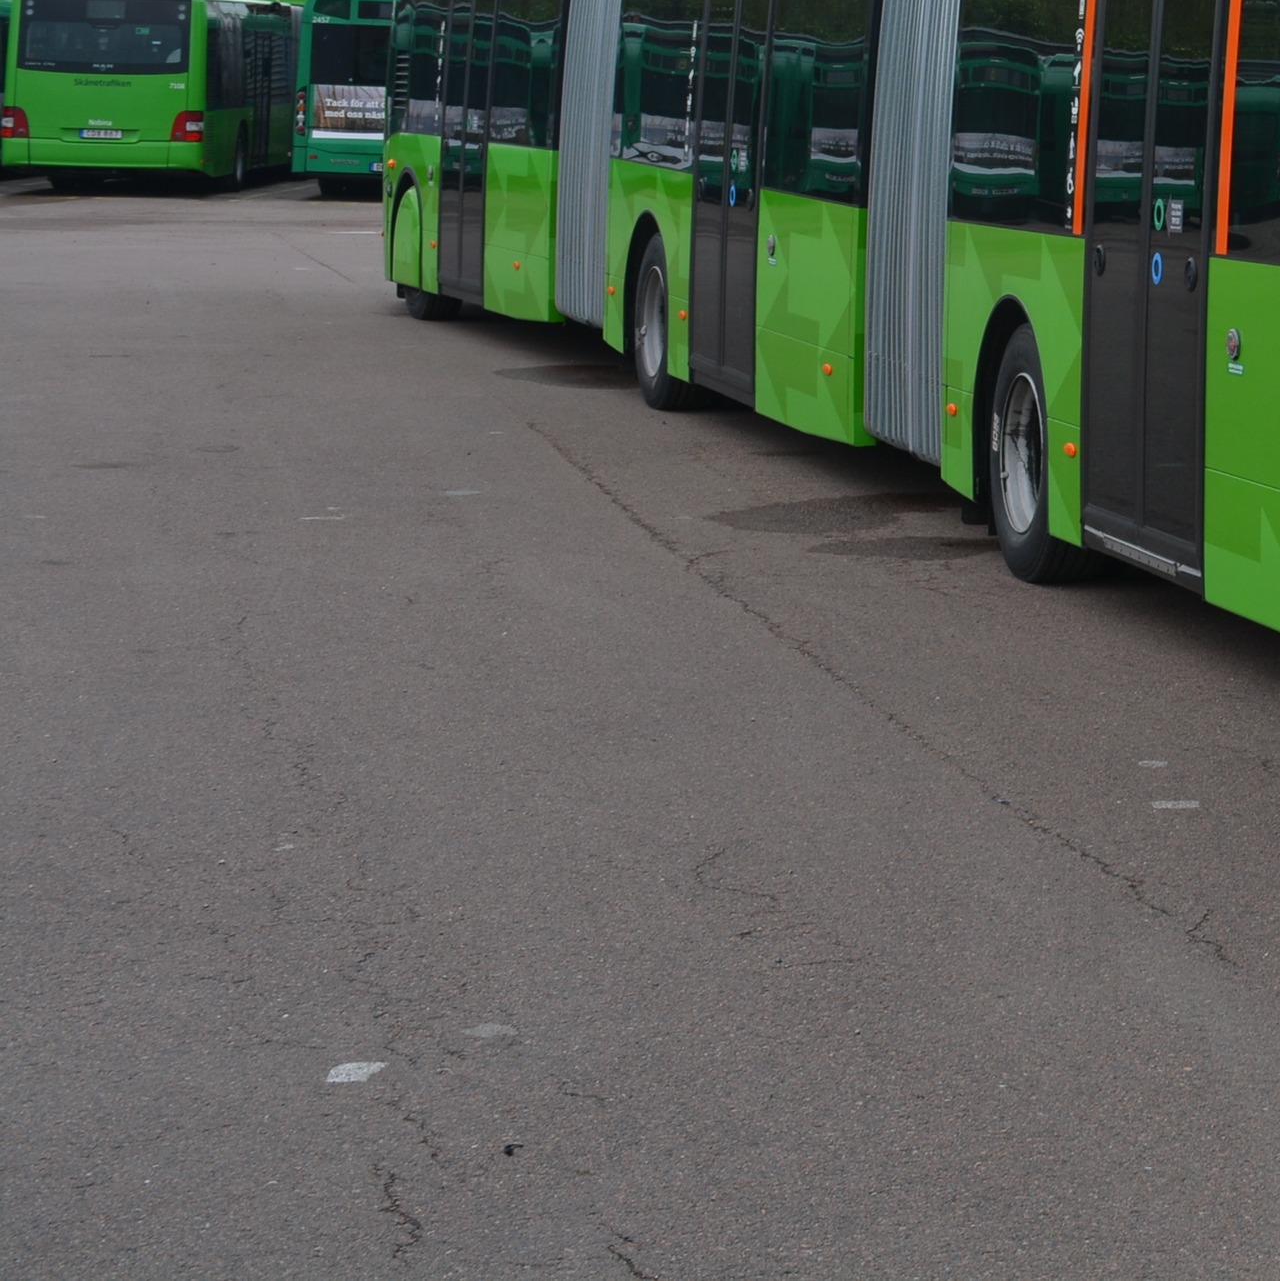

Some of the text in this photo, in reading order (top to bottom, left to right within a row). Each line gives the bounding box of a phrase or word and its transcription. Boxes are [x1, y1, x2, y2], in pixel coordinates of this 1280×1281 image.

[73, 78, 132, 87] Skånetrafiken
[325, 98, 348, 107] Tack
[350, 99, 364, 108] för
